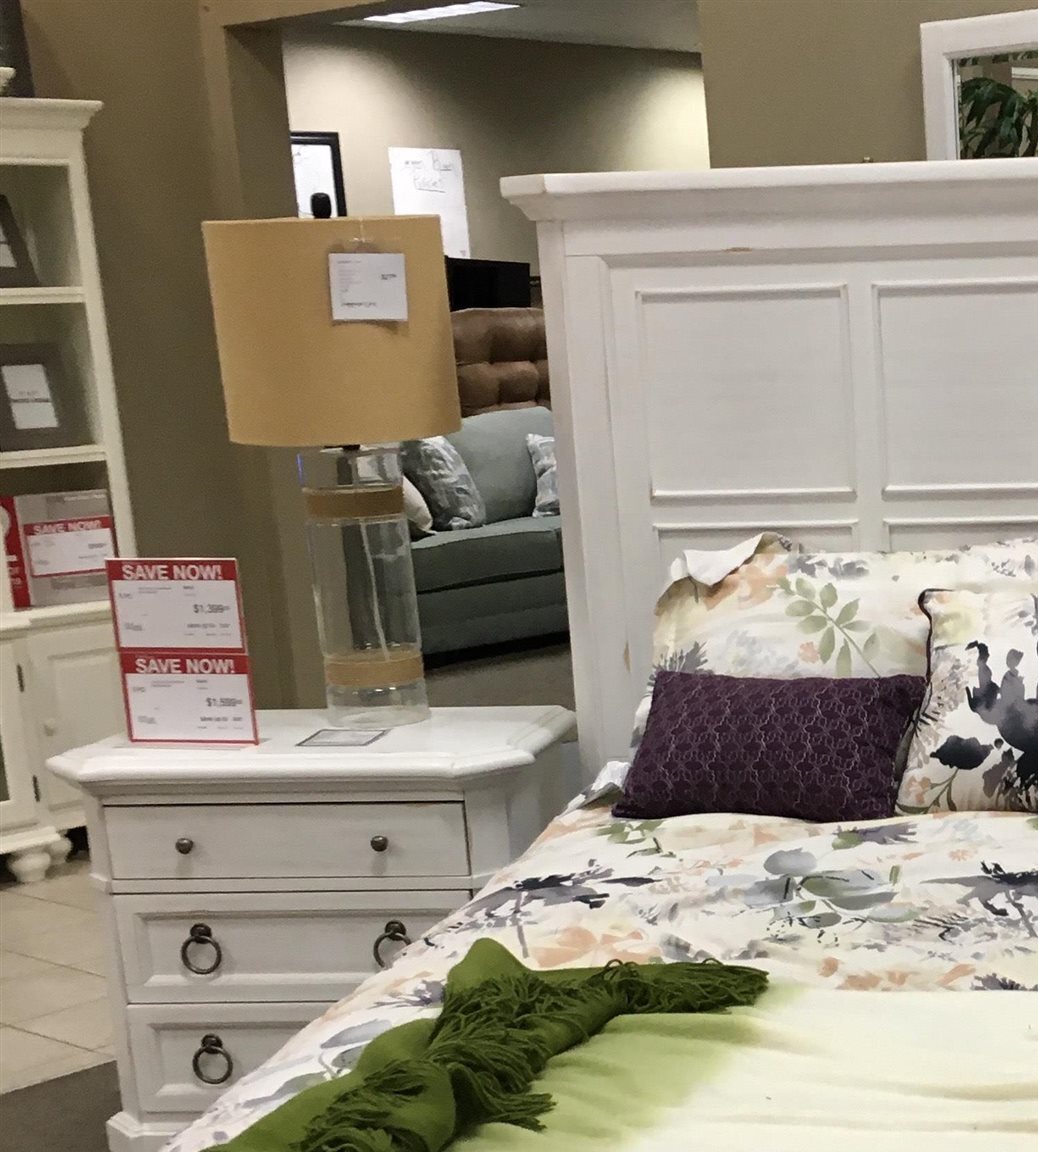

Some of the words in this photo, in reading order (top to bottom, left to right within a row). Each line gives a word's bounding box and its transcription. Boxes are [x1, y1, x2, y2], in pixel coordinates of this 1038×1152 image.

[121, 564, 168, 580] SAVE
[173, 564, 223, 580] NOW!
[135, 658, 181, 674] SAVE
[186, 658, 235, 674] NOW!
